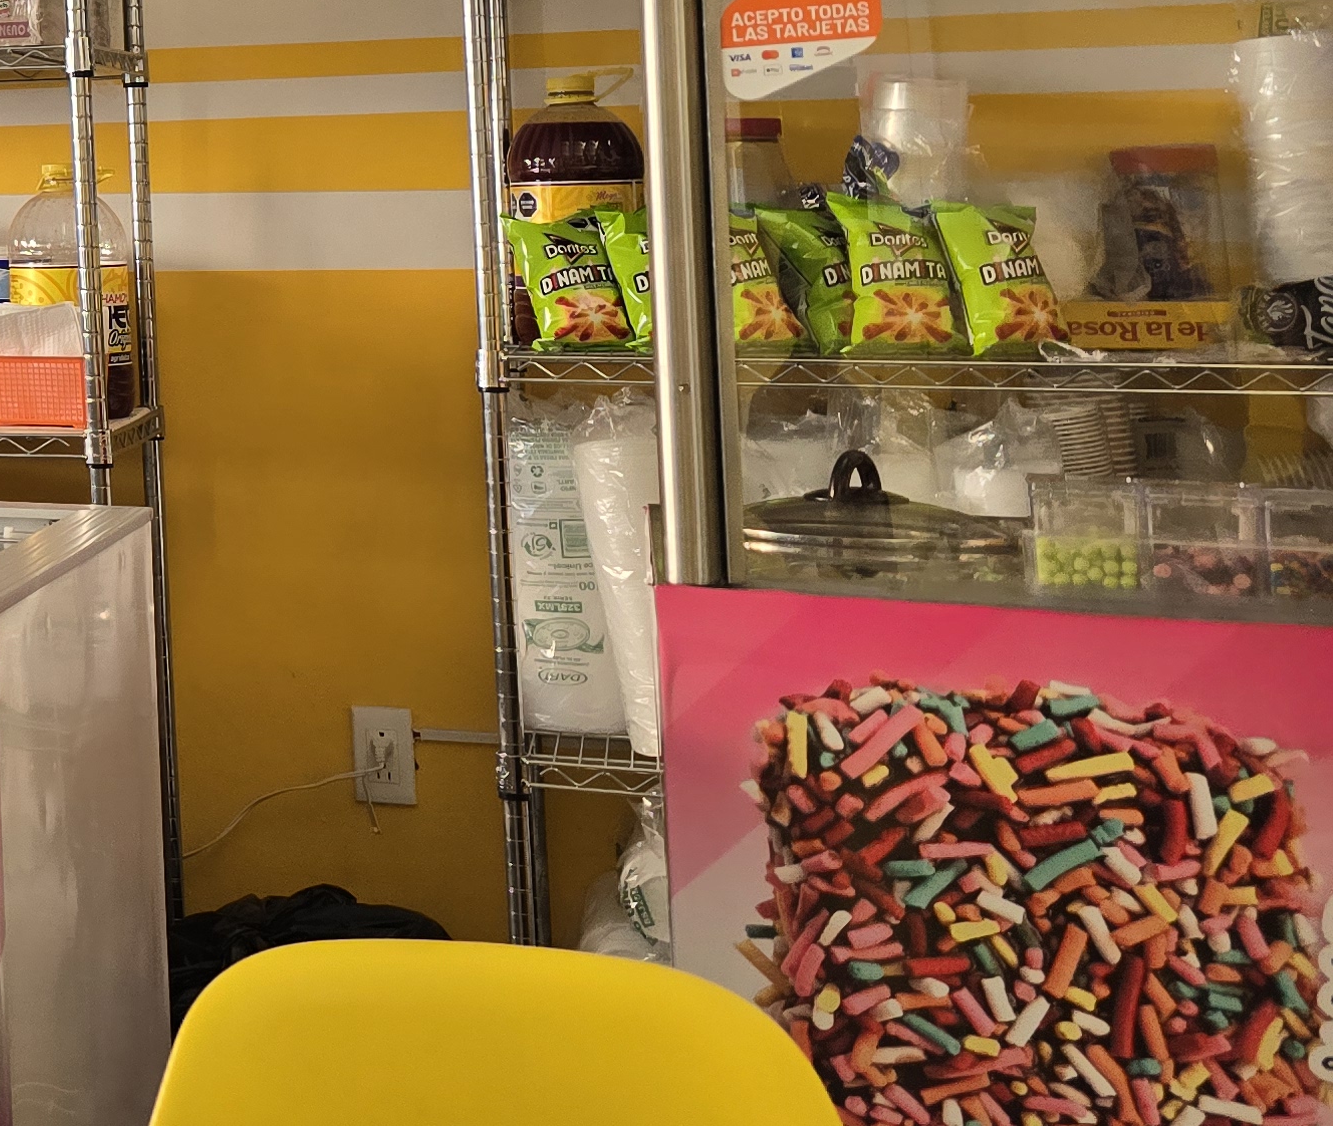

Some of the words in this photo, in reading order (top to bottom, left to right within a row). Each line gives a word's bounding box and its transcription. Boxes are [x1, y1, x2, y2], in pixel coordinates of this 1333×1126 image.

[730, 6, 804, 28] ACEPTO
[806, 0, 870, 21] TODAS
[732, 26, 769, 43] LAS
[772, 16, 870, 39] TARJETAS
[728, 53, 751, 62] VISA
[870, 231, 929, 248] Doritos
[544, 243, 598, 259] Doritos
[1067, 320, 1135, 342] Rosa
[1144, 320, 1172, 342] la
